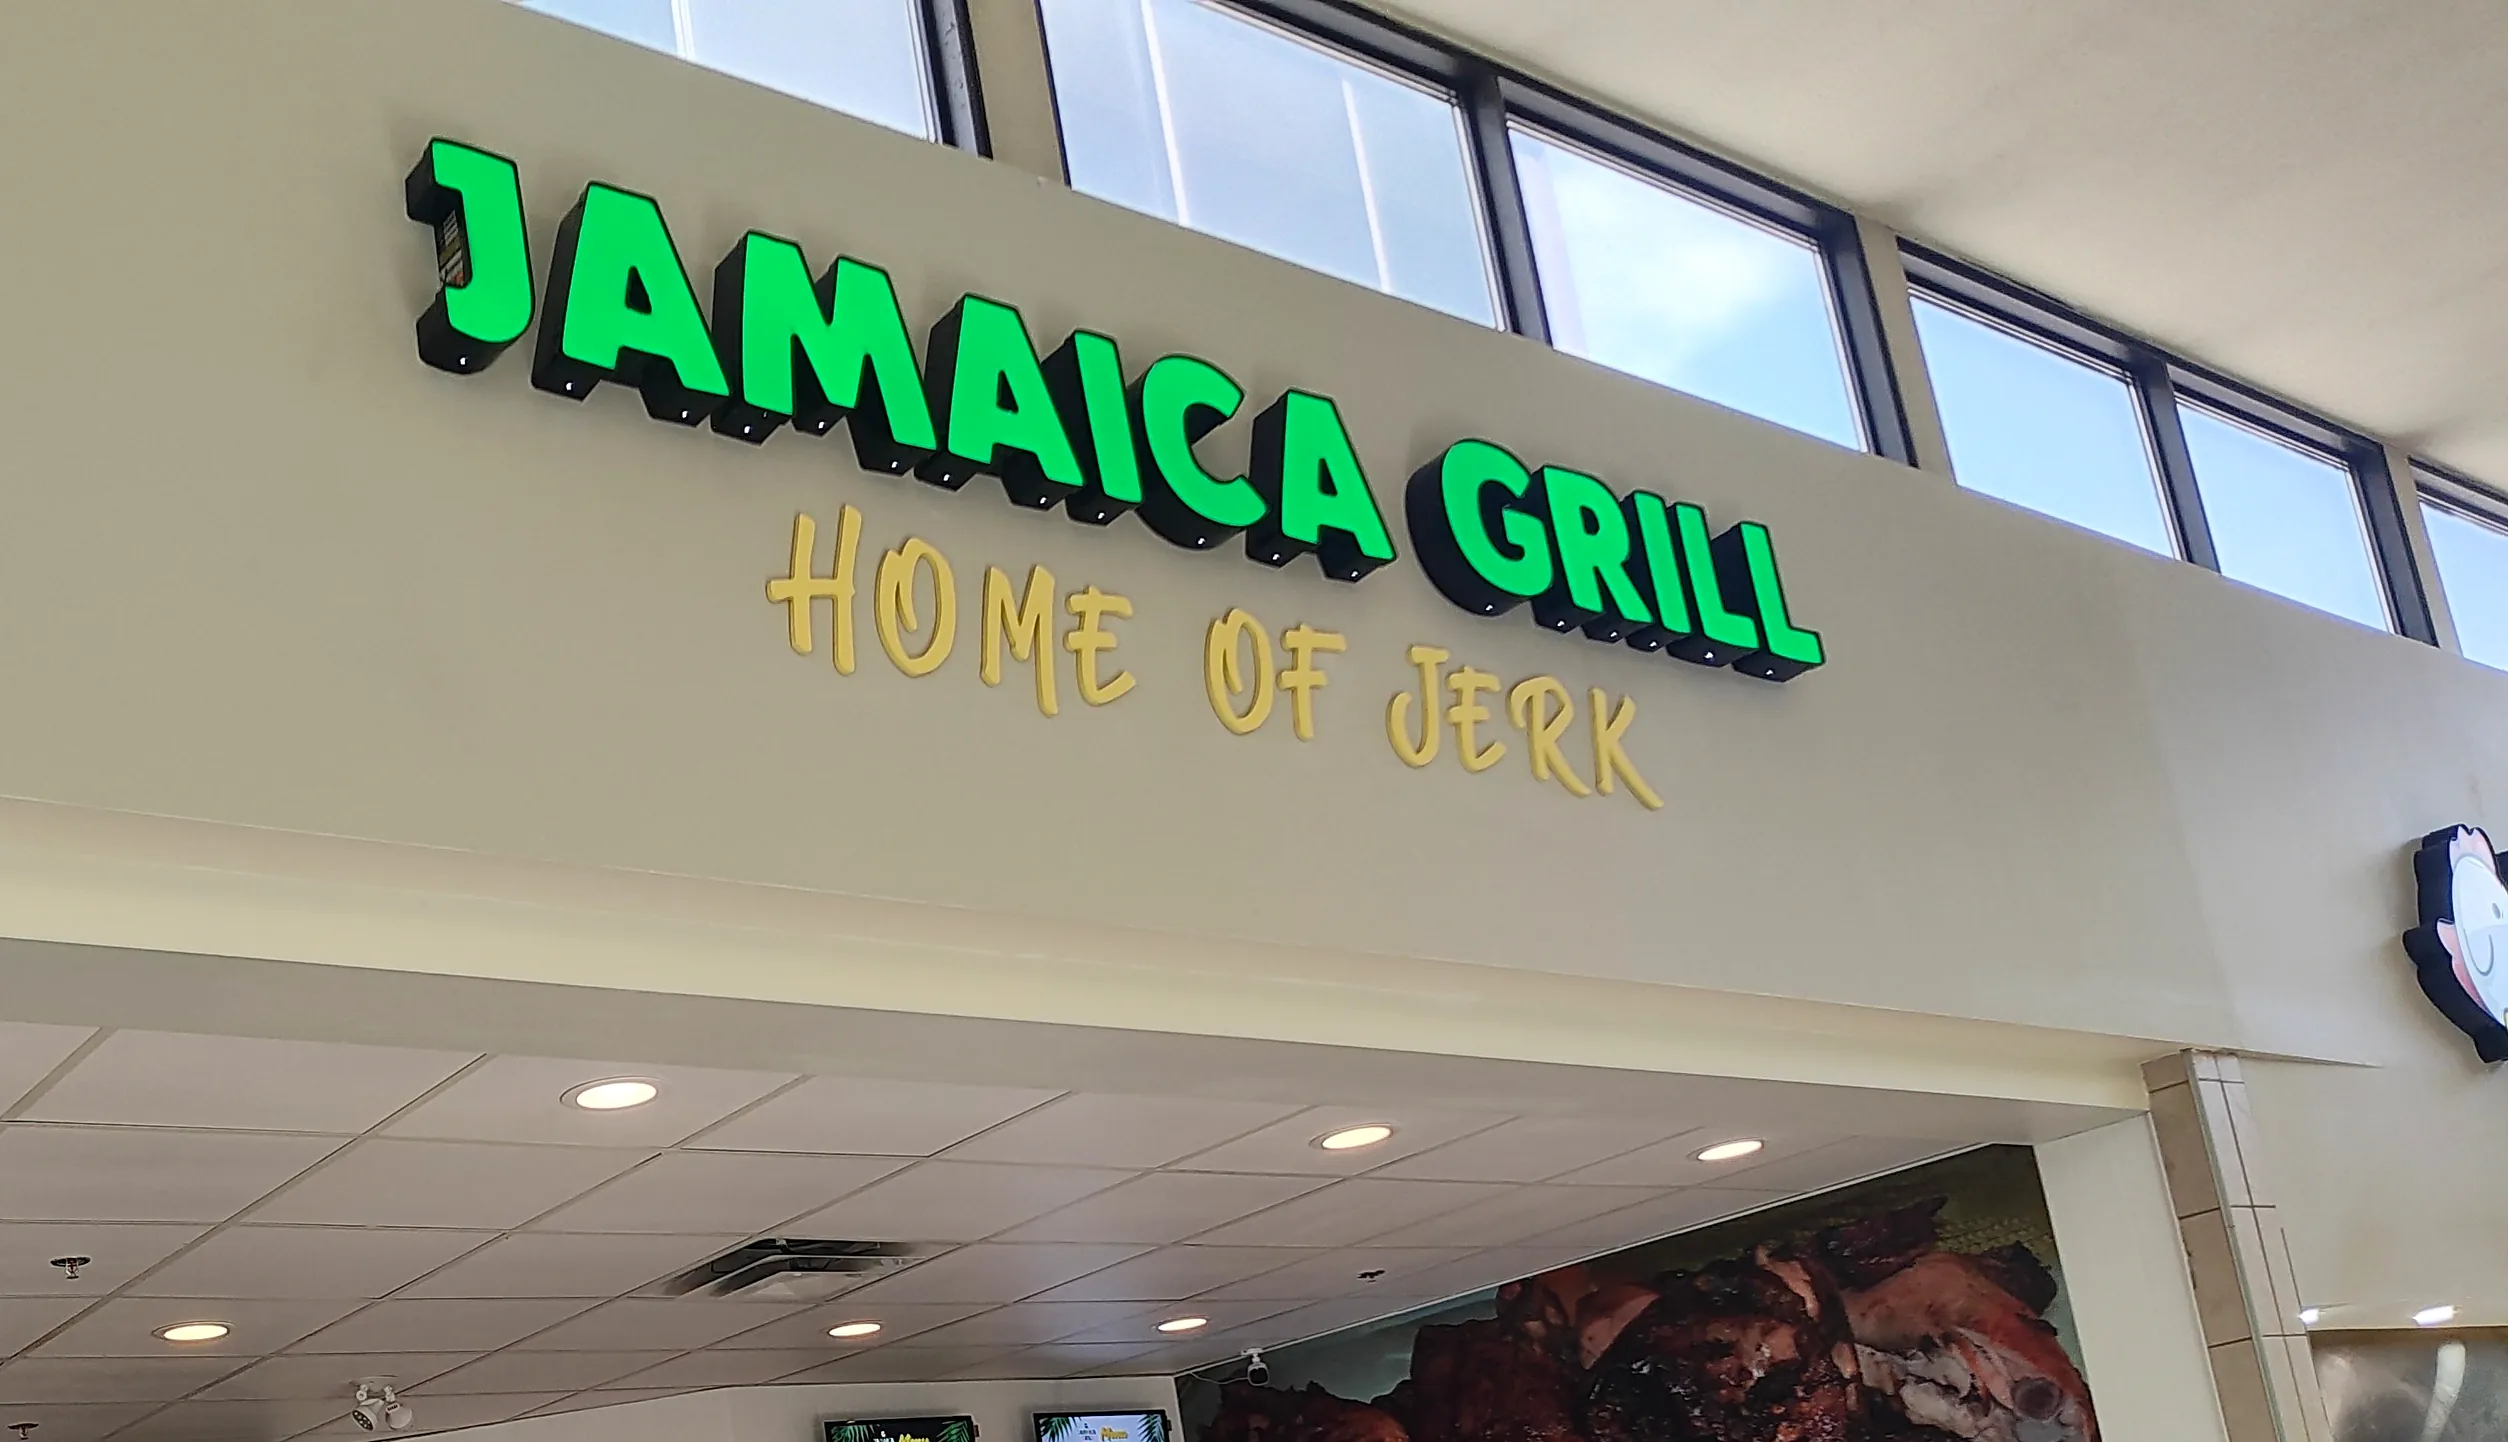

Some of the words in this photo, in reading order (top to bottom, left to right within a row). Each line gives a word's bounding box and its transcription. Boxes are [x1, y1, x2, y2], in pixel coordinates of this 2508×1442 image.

[429, 139, 1396, 562] JAMAICA
[1440, 439, 1824, 665] GRILL
[765, 504, 1136, 719] HOME
[1203, 609, 1346, 741] OF
[1385, 644, 1664, 810] JERK
